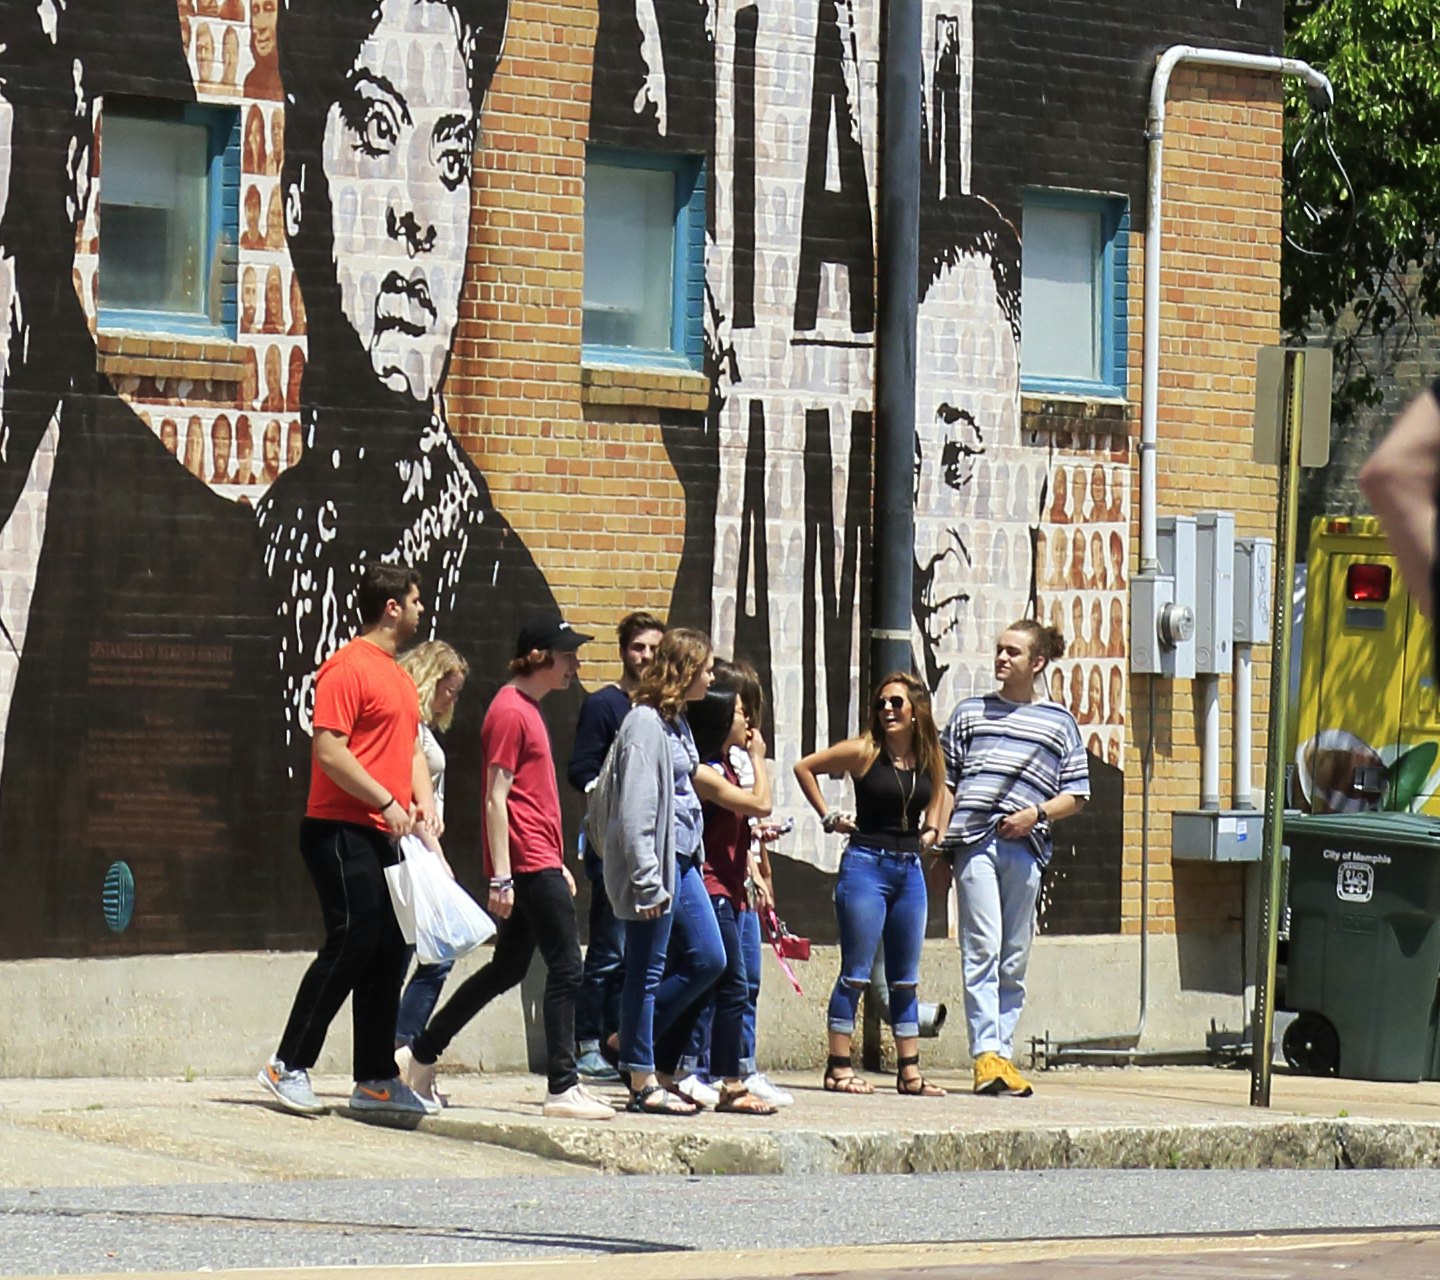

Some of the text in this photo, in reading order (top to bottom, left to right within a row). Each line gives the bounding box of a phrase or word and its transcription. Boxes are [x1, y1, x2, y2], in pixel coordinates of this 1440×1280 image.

[1323, 849, 1391, 864] City of Memphis
